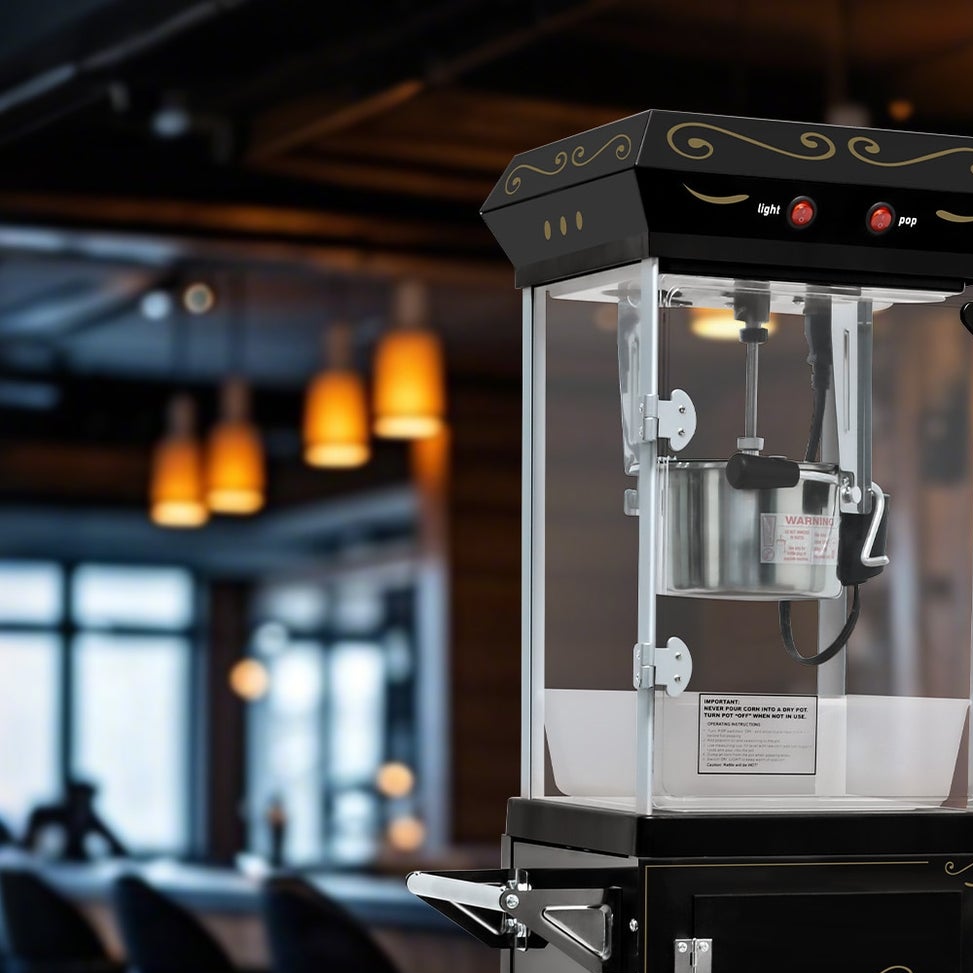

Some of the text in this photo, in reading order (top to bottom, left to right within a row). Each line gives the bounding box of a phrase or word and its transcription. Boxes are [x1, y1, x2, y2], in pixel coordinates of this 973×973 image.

[757, 203, 781, 216] light
[898, 215, 918, 228] pop
[785, 516, 834, 526] WARNING
